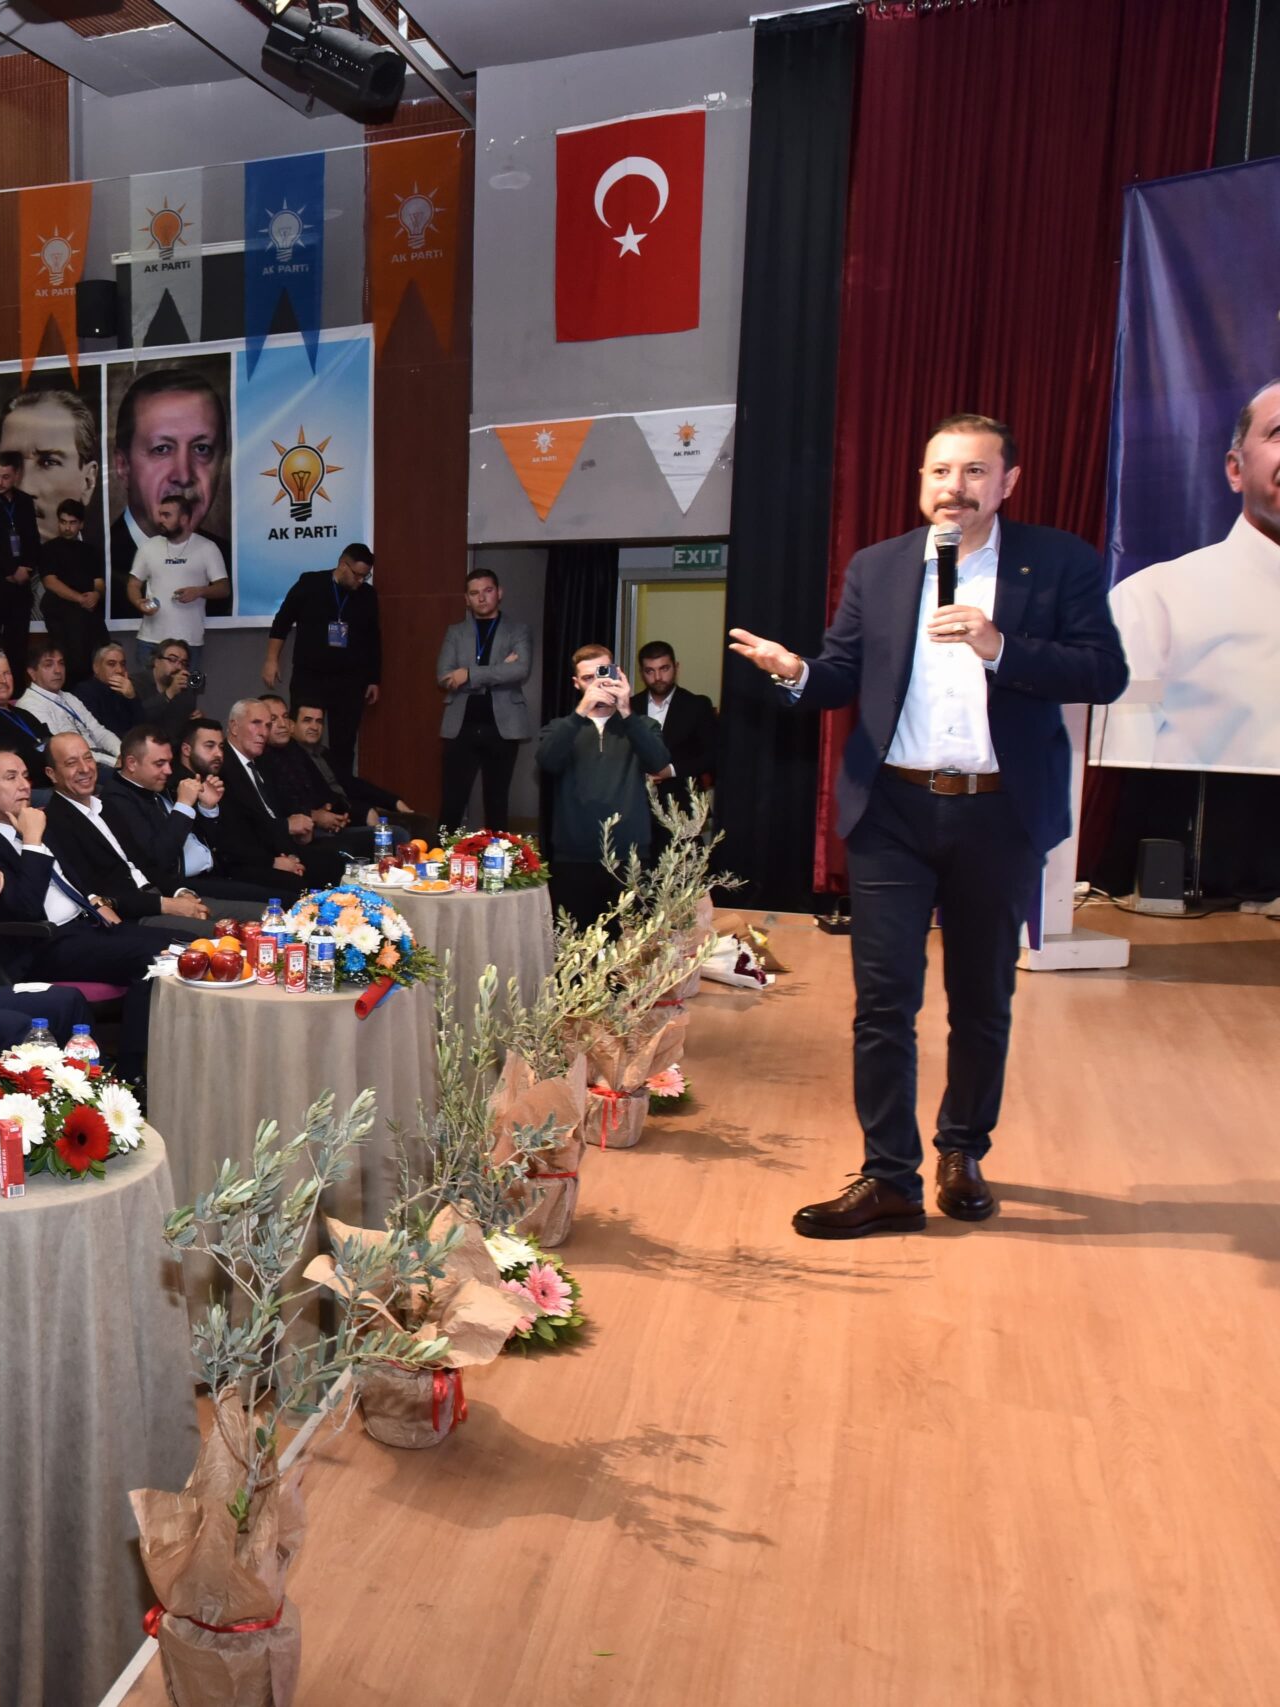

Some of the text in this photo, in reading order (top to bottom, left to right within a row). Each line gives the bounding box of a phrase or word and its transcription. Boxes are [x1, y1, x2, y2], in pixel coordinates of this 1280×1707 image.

[391, 254, 407, 263] AK
[143, 263, 158, 273] AK
[262, 266, 275, 275] AK
[34, 288, 48, 297] AK
[268, 527, 290, 541] AK
[674, 550, 719, 564] EXIT
